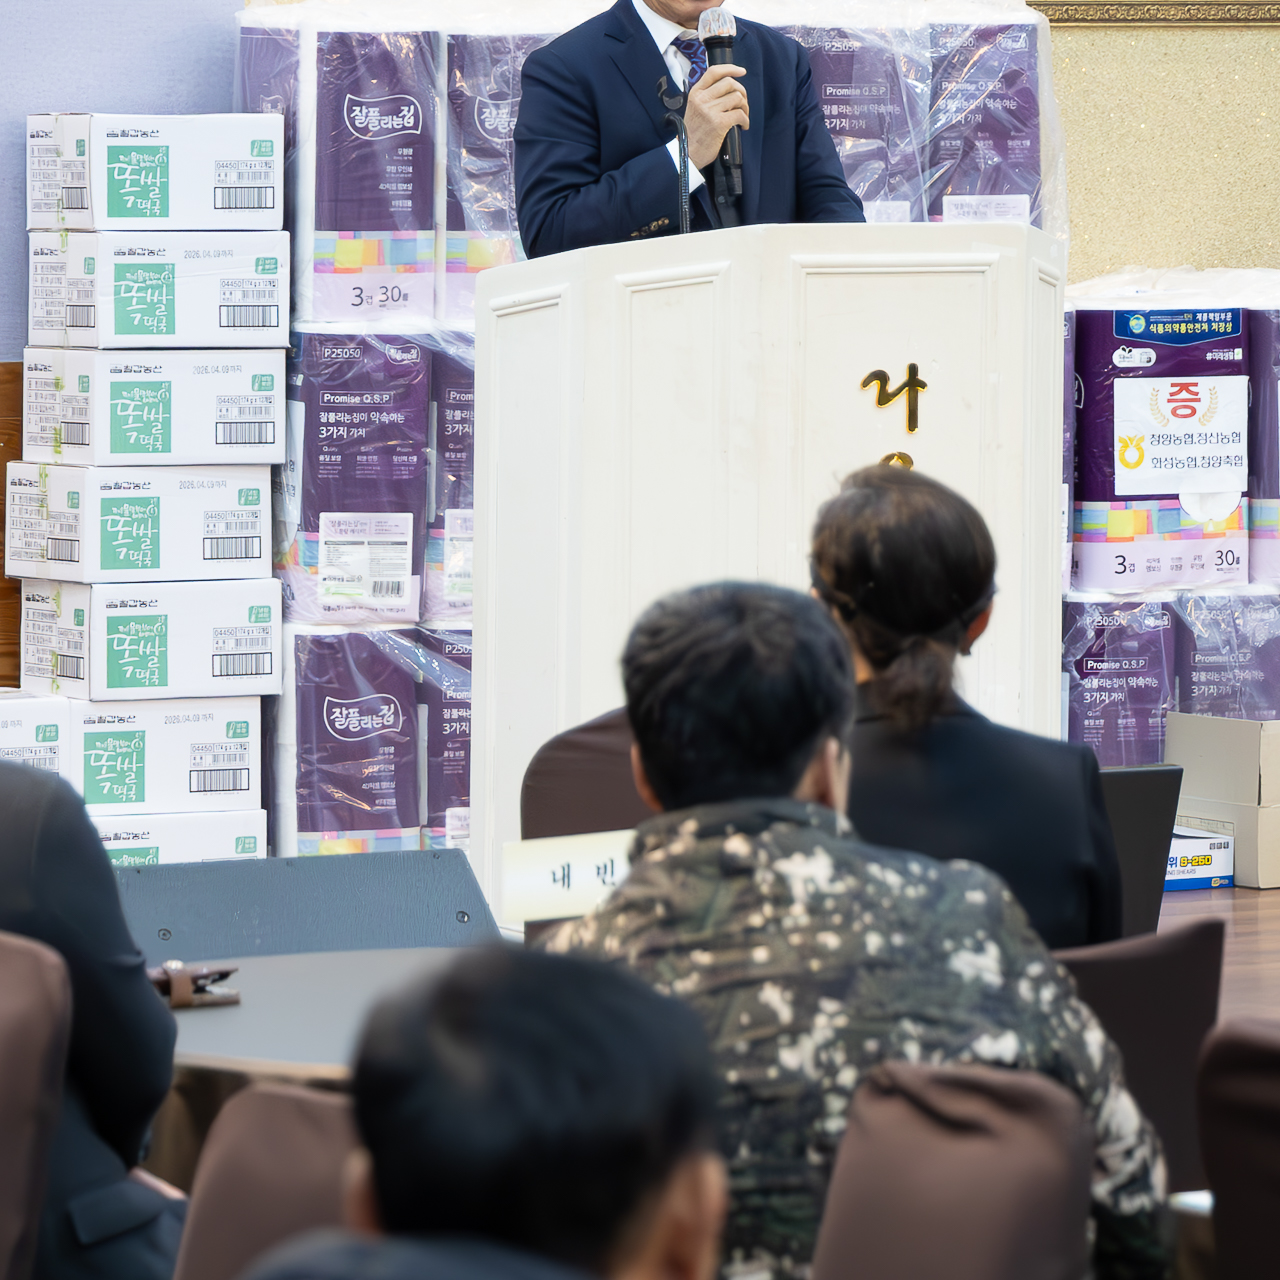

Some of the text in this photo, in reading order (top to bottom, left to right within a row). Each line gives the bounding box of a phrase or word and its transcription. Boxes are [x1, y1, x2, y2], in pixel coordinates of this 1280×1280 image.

[826, 87, 861, 96] Promise
[350, 104, 415, 131] 잘풀리는집
[1149, 321, 1233, 334] 식품의약품안전처 처장상
[324, 347, 361, 359] P25050
[323, 393, 390, 405] Promise Q.S.P
[1167, 381, 1202, 419] 증
[318, 426, 348, 439] 3가지
[1149, 431, 1242, 447] 청양농협.정산농협
[1150, 454, 1244, 470] 화성농협.청양축협
[445, 644, 472, 654] P250
[1087, 659, 1146, 670] Promise Q.S.P
[446, 690, 472, 700] Prom
[1083, 691, 1109, 704] 3가지
[330, 703, 395, 732] 잘풀리는집
[442, 722, 470, 735] 3가지
